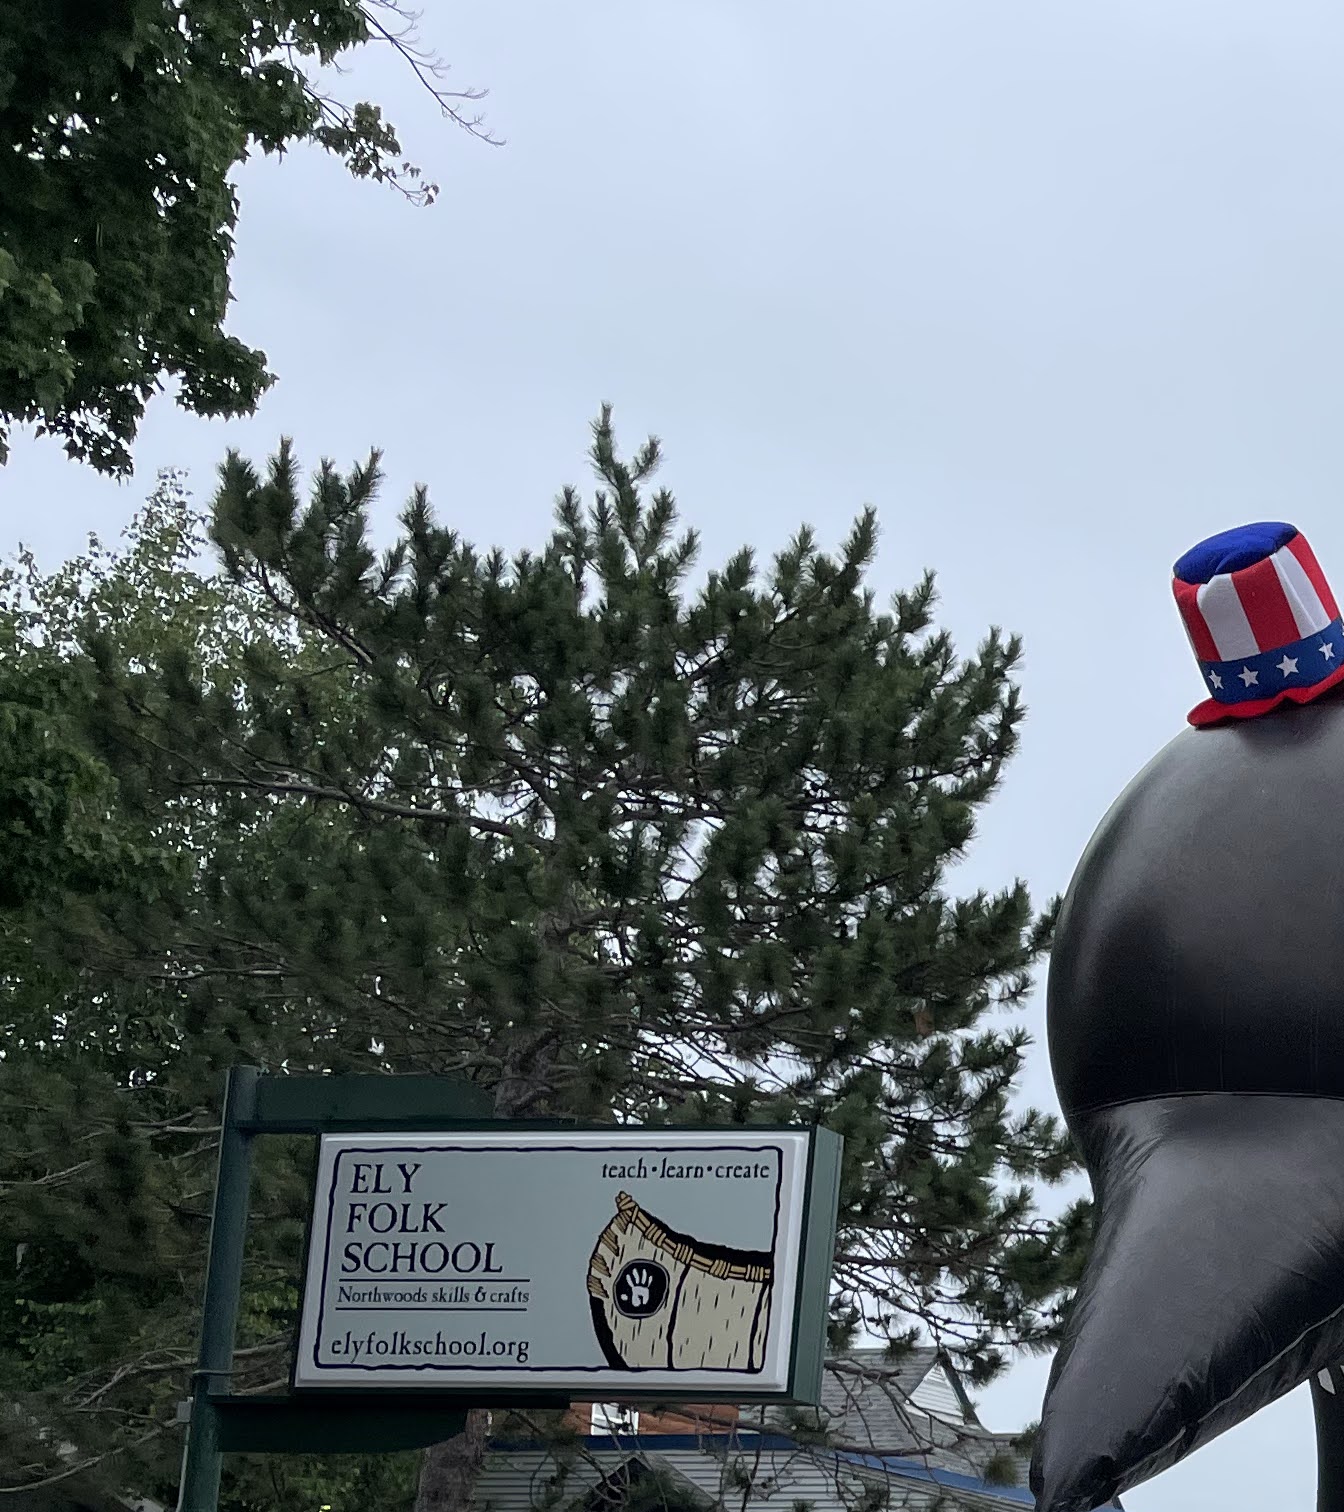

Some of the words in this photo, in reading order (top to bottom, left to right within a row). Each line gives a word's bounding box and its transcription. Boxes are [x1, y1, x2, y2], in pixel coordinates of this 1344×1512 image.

[350, 1163, 422, 1194] ELY
[346, 1202, 448, 1234] FOLK
[341, 1241, 503, 1273] SCHOOL
[337, 1285, 428, 1303] Northwoods
[431, 1286, 470, 1303] skills
[474, 1286, 487, 1303] &
[489, 1286, 530, 1303] crafts
[331, 1330, 530, 1364] elyfolkschool.org
